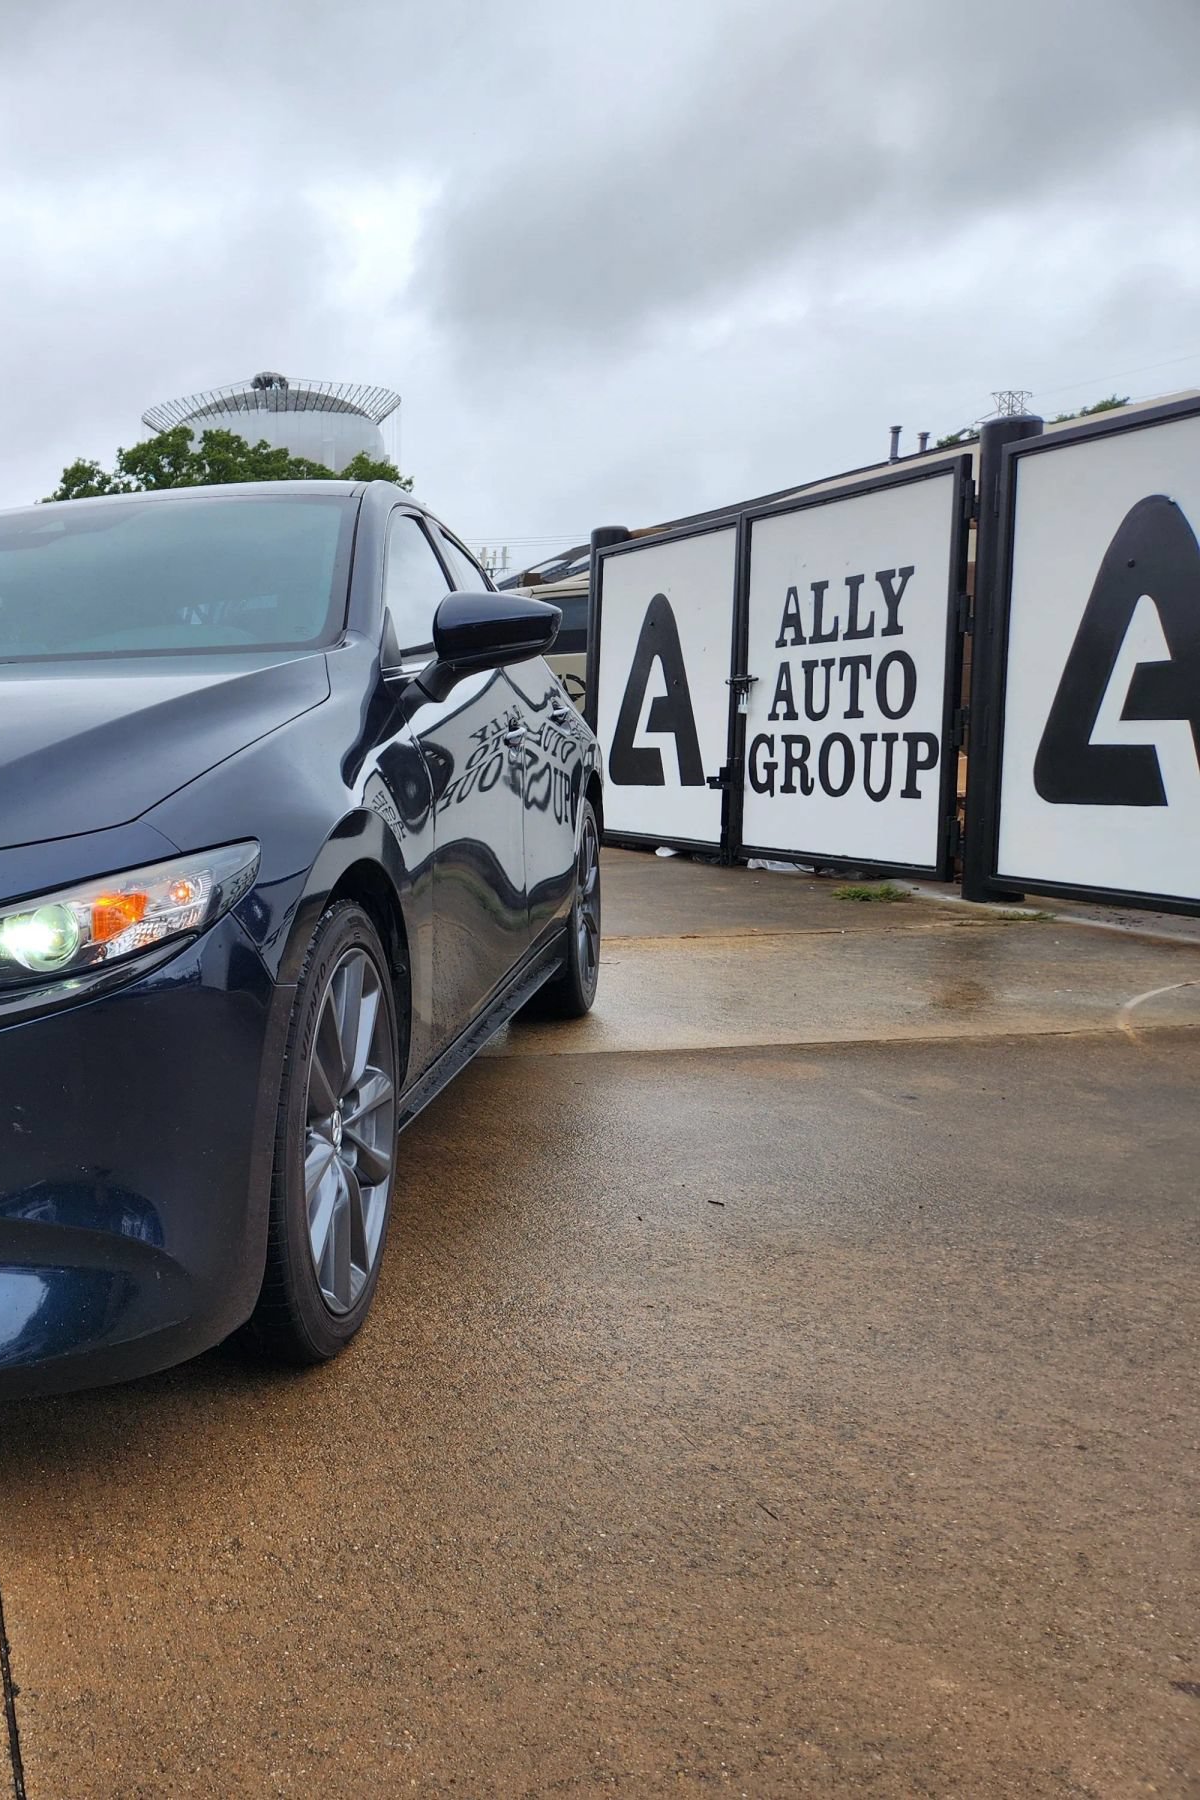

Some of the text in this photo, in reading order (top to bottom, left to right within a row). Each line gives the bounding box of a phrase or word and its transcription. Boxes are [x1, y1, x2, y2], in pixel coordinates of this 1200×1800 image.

[775, 565, 915, 648] ALLY
[767, 650, 917, 722] AUTO
[748, 732, 940, 802] GROUP
